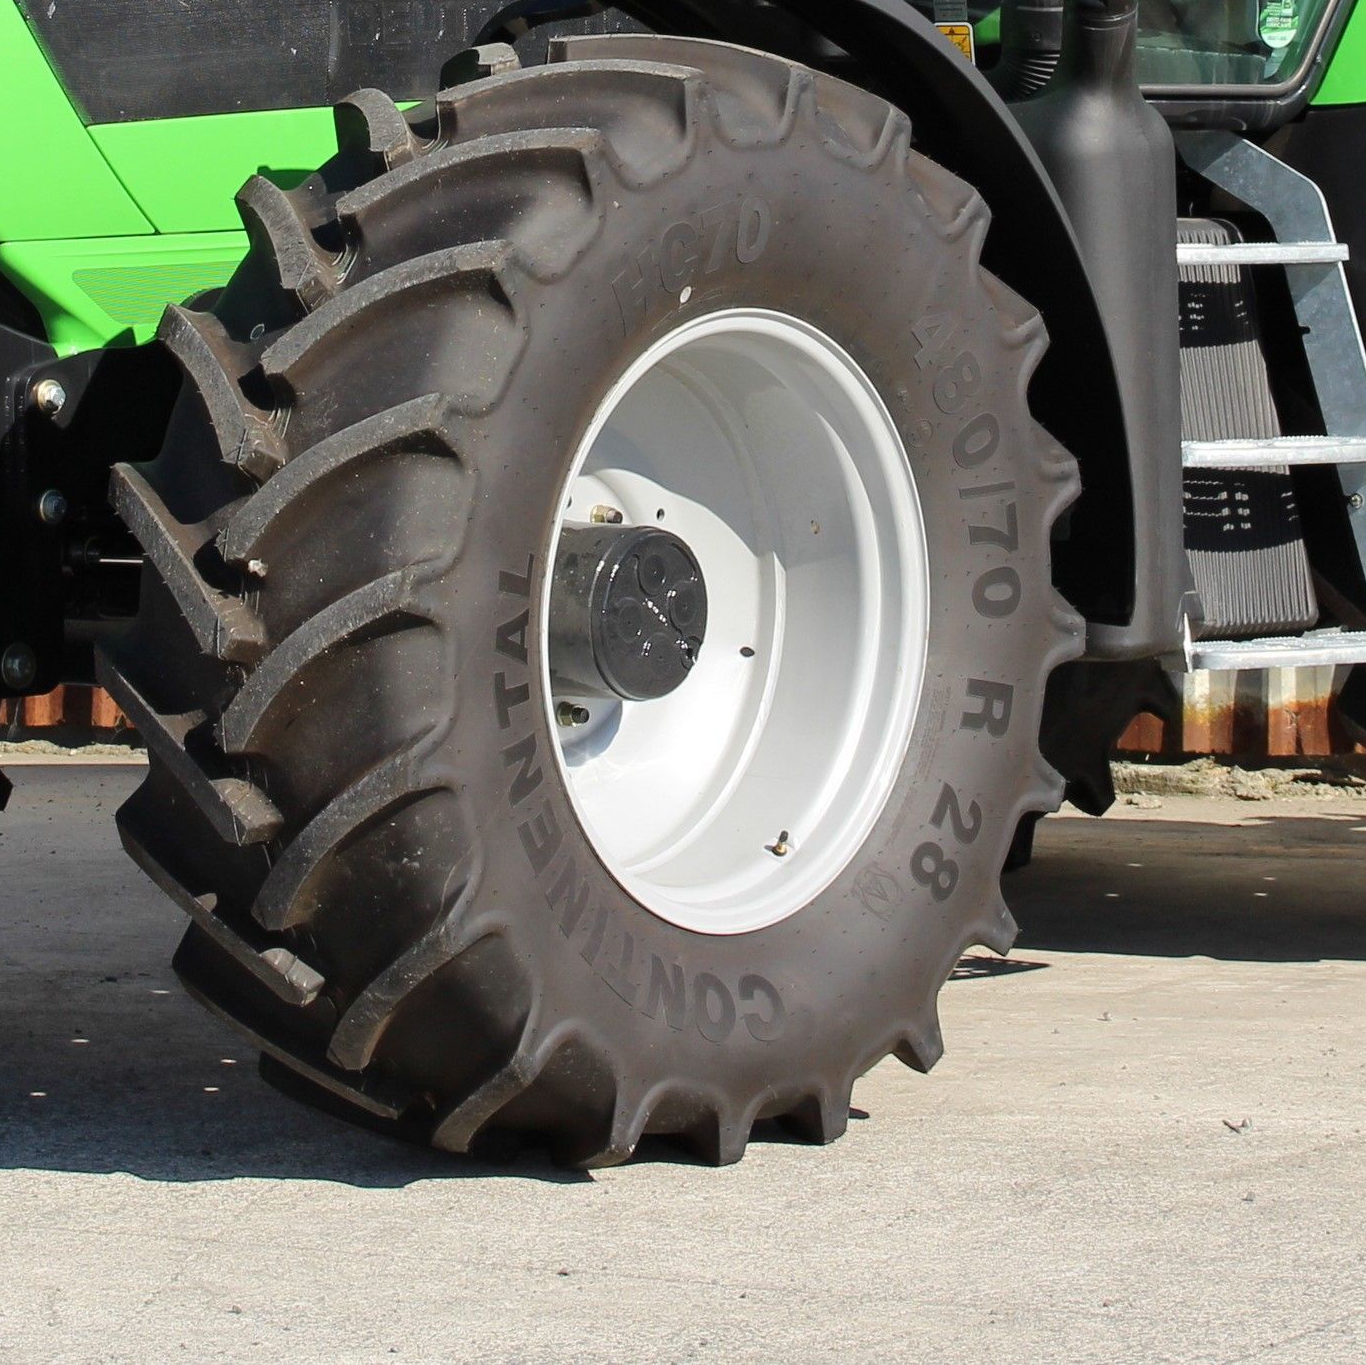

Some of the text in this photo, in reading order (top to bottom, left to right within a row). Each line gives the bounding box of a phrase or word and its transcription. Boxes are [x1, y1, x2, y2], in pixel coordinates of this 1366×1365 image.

[910, 311, 1023, 620] 480/70
[494, 551, 787, 1044] CONTINENTAL
[959, 677, 1015, 739] R
[908, 781, 984, 903] 28
